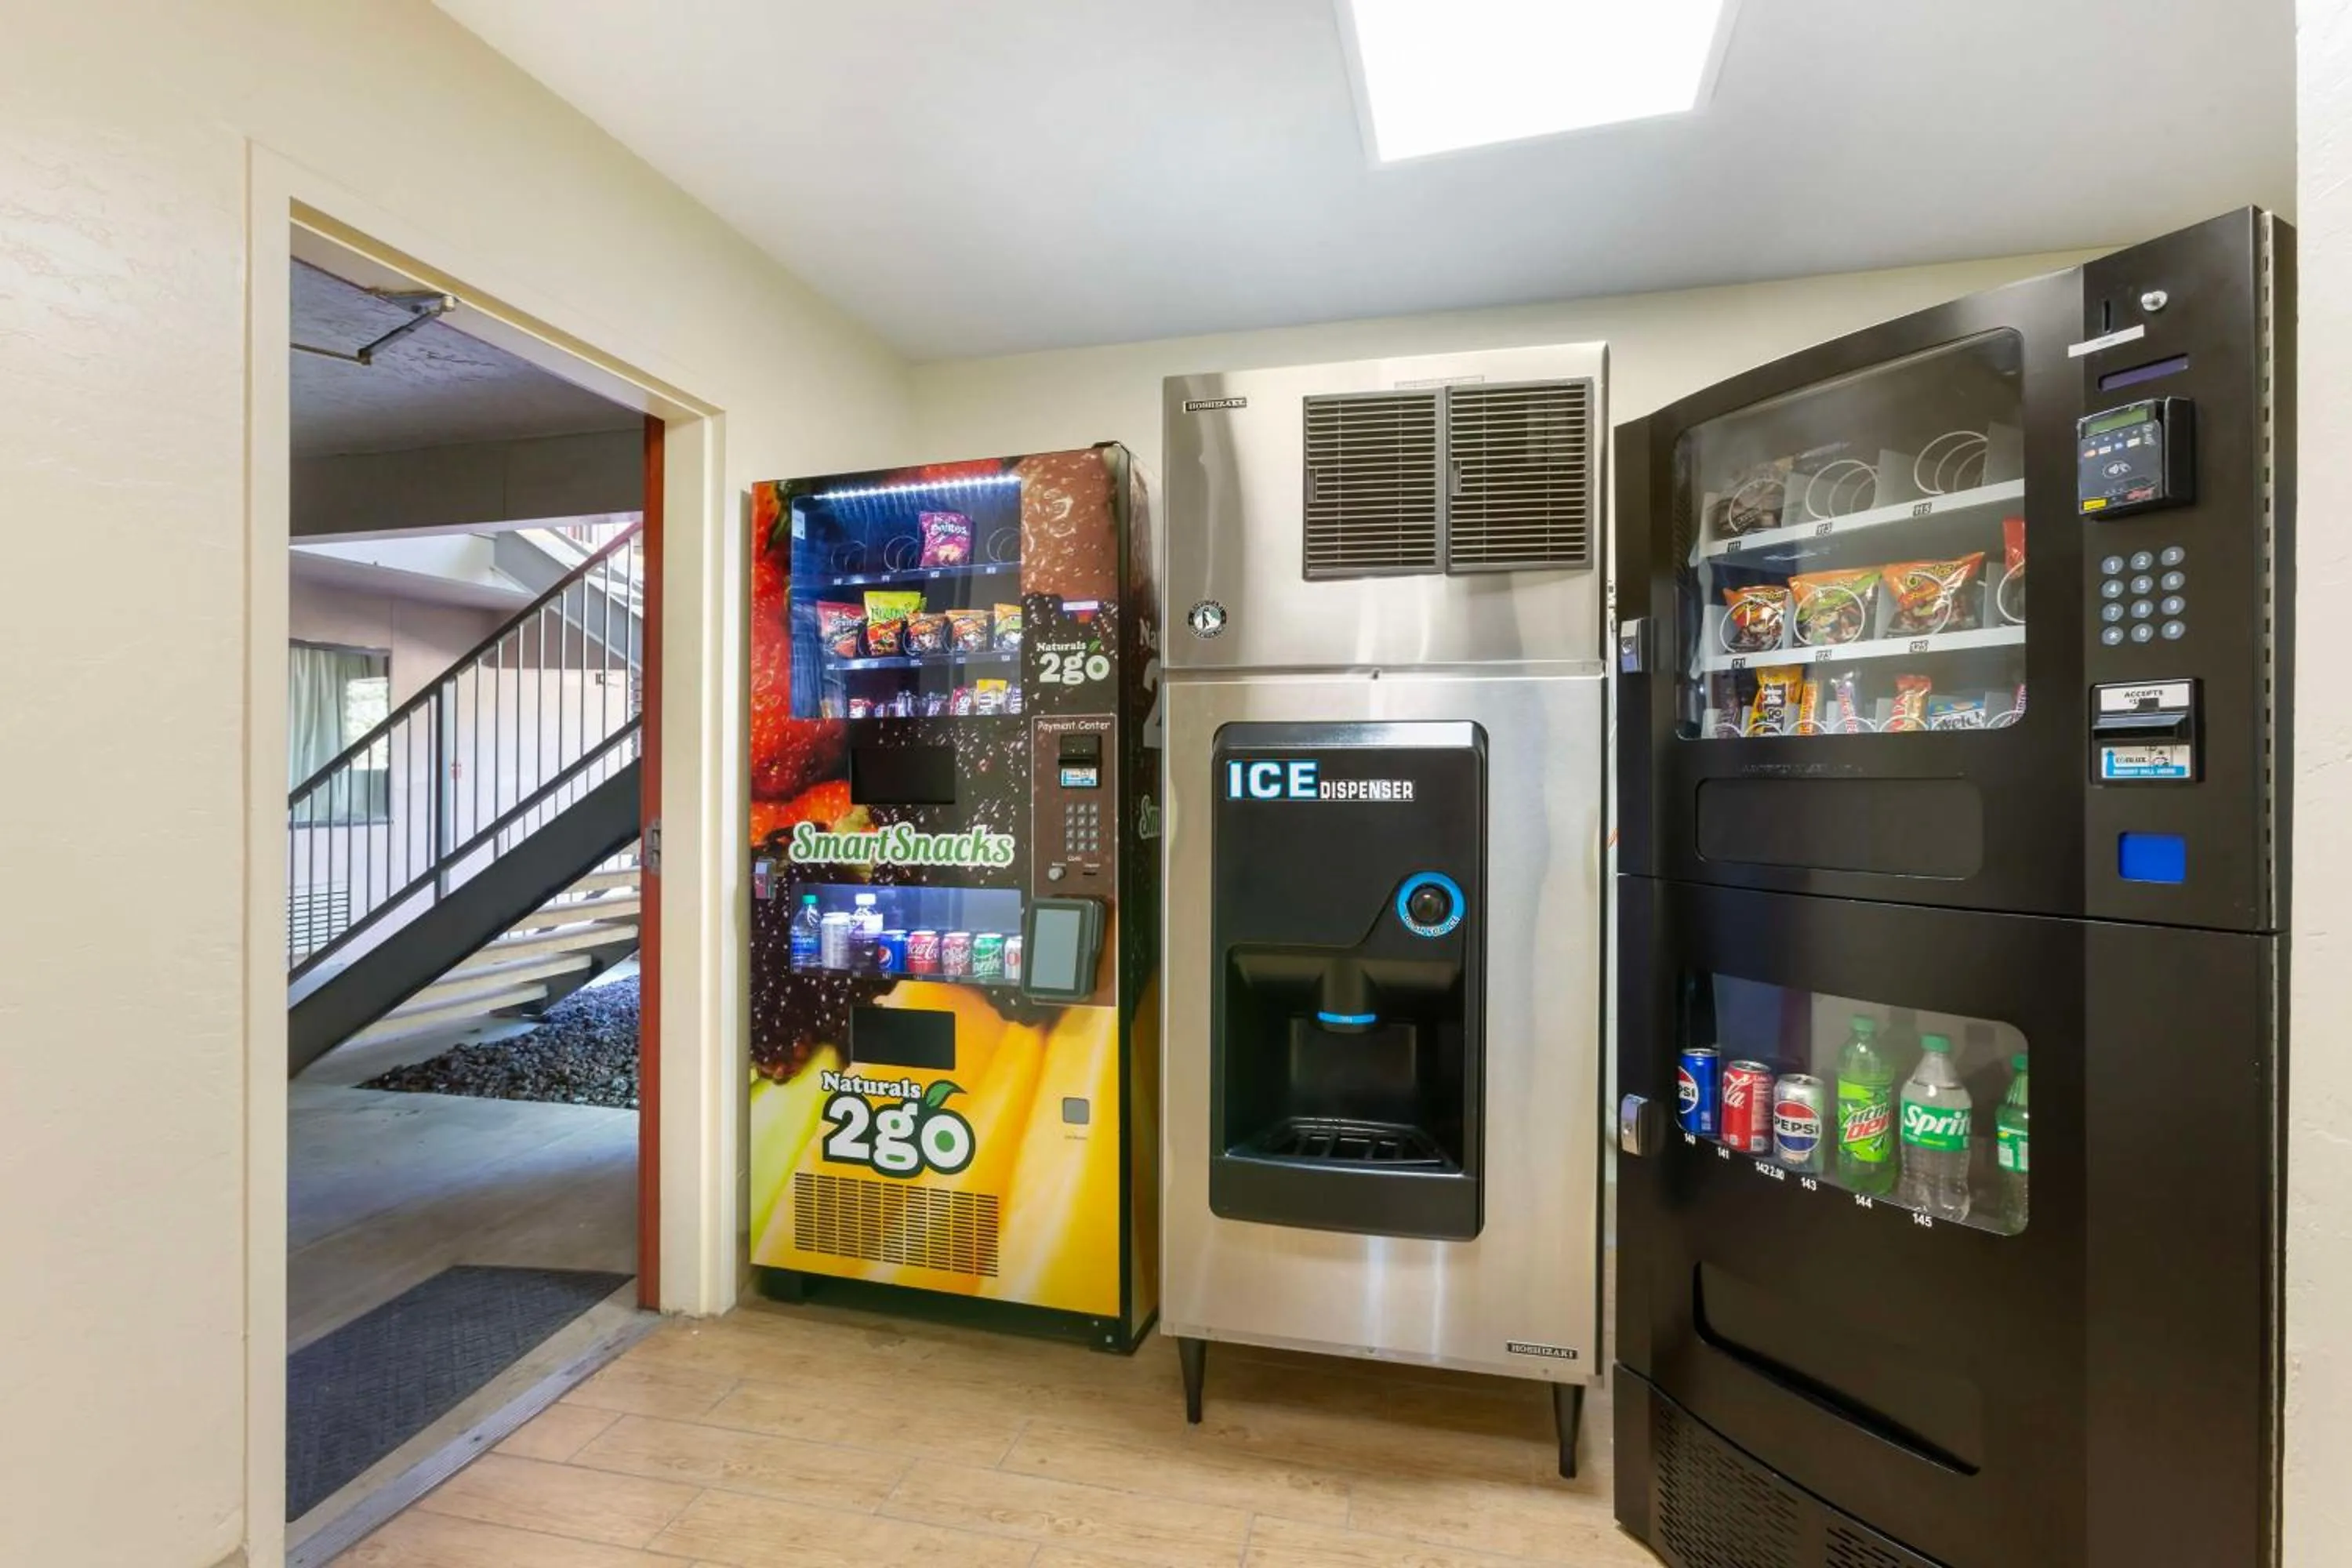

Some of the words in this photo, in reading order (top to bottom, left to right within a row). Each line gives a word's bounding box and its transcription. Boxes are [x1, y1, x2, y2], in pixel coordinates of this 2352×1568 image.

[1036, 641, 1087, 652] Naturals
[1039, 652, 1110, 684] 2go
[1037, 720, 1076, 734] Payment
[1078, 720, 1110, 731] Center
[1229, 761, 1318, 798] ICE
[1319, 781, 1414, 799] DISPENSER
[791, 822, 1014, 865] SmartSnacks
[822, 1072, 921, 1099] Naturals
[826, 1094, 972, 1174] 2go
[1718, 1146, 1730, 1160] 141
[1755, 1161, 1769, 1174] 142
[1800, 1177, 1817, 1191] 143
[1855, 1194, 1873, 1208] 144
[1913, 1213, 1933, 1228] 145
